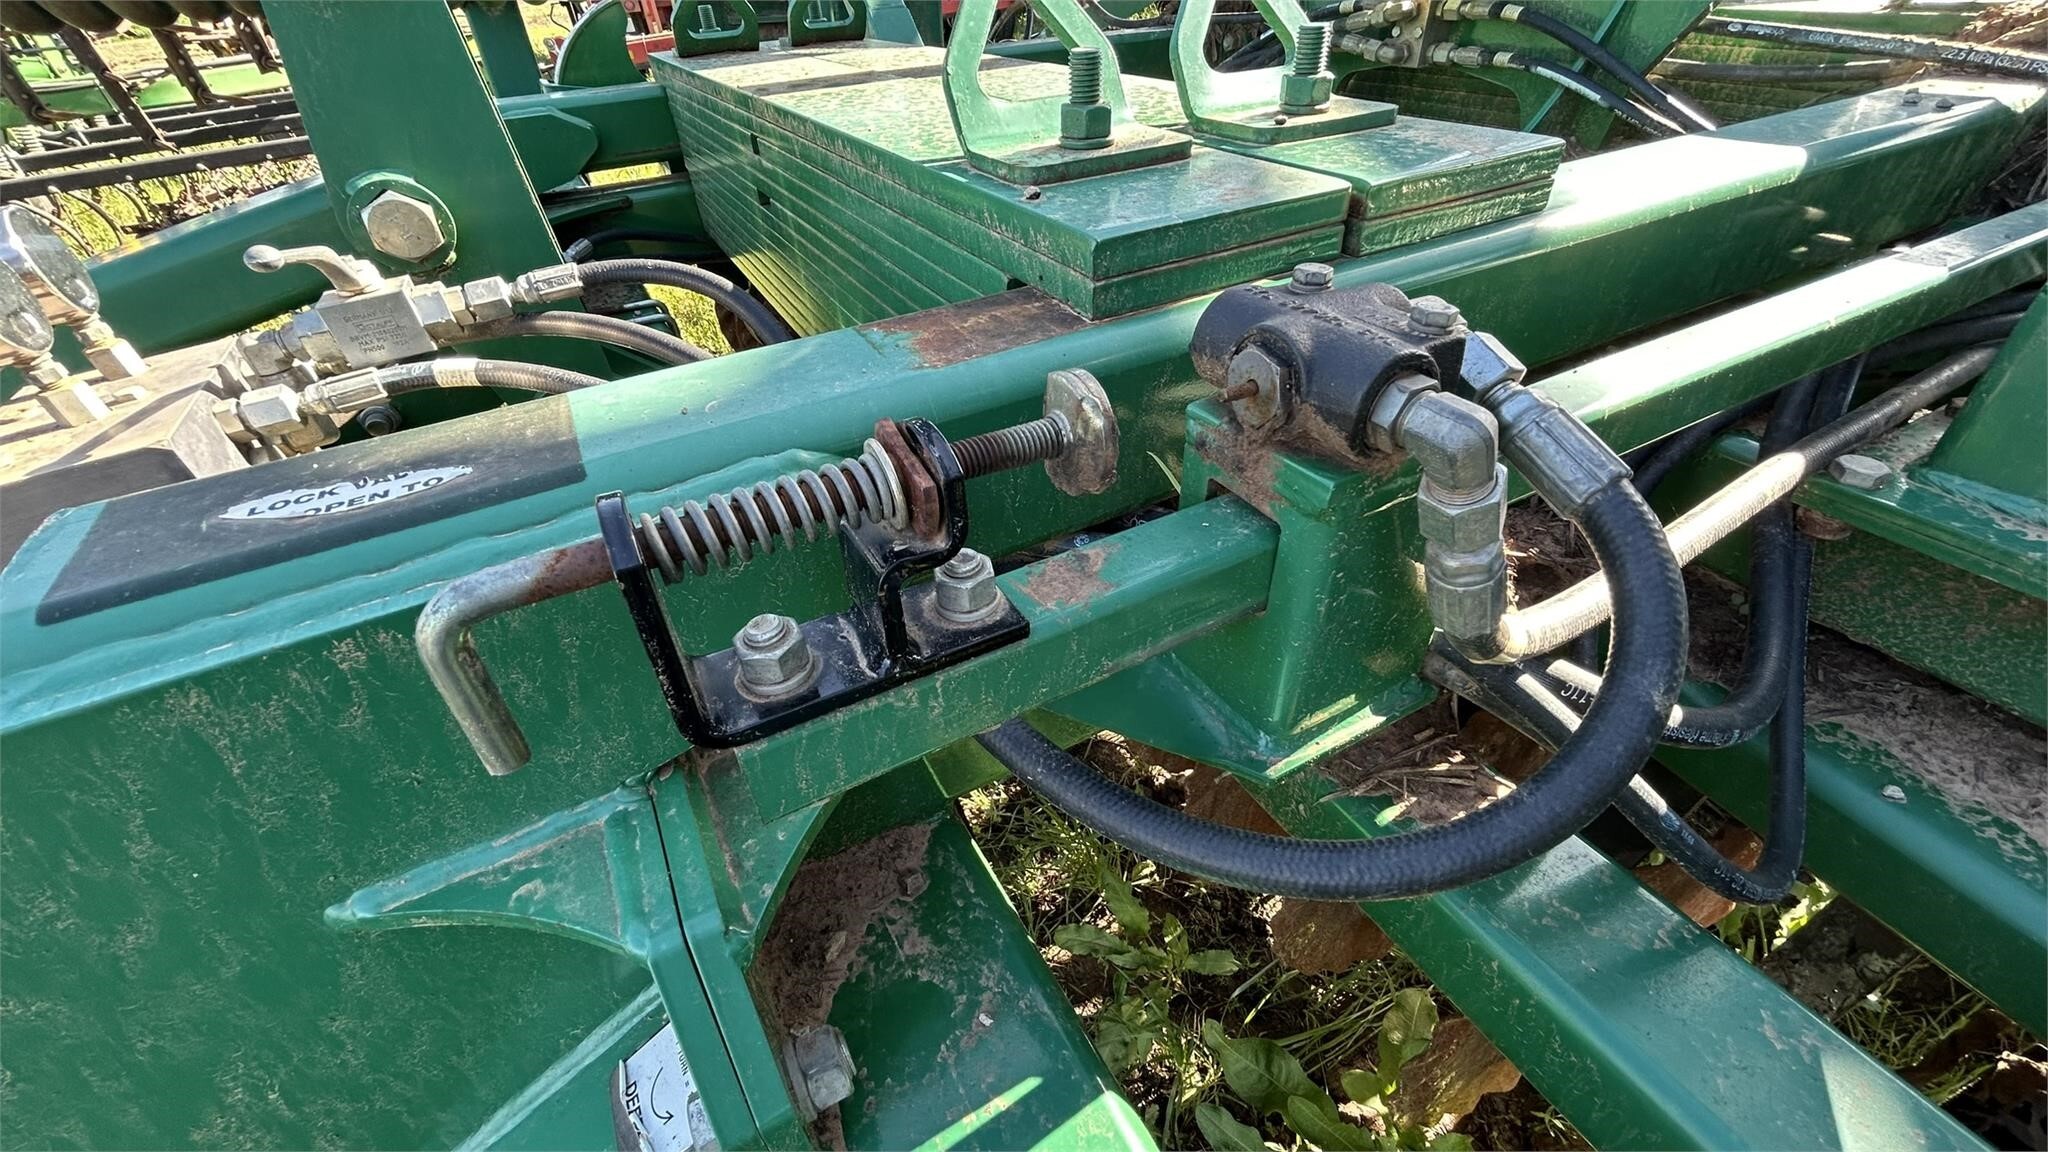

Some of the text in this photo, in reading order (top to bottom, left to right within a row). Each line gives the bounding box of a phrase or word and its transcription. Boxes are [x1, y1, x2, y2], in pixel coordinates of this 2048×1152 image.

[1941, 48, 1969, 61] 22.5
[1966, 51, 1995, 65] MPa
[246, 486, 341, 517] LOCK
[303, 477, 445, 516] OPEN TO
